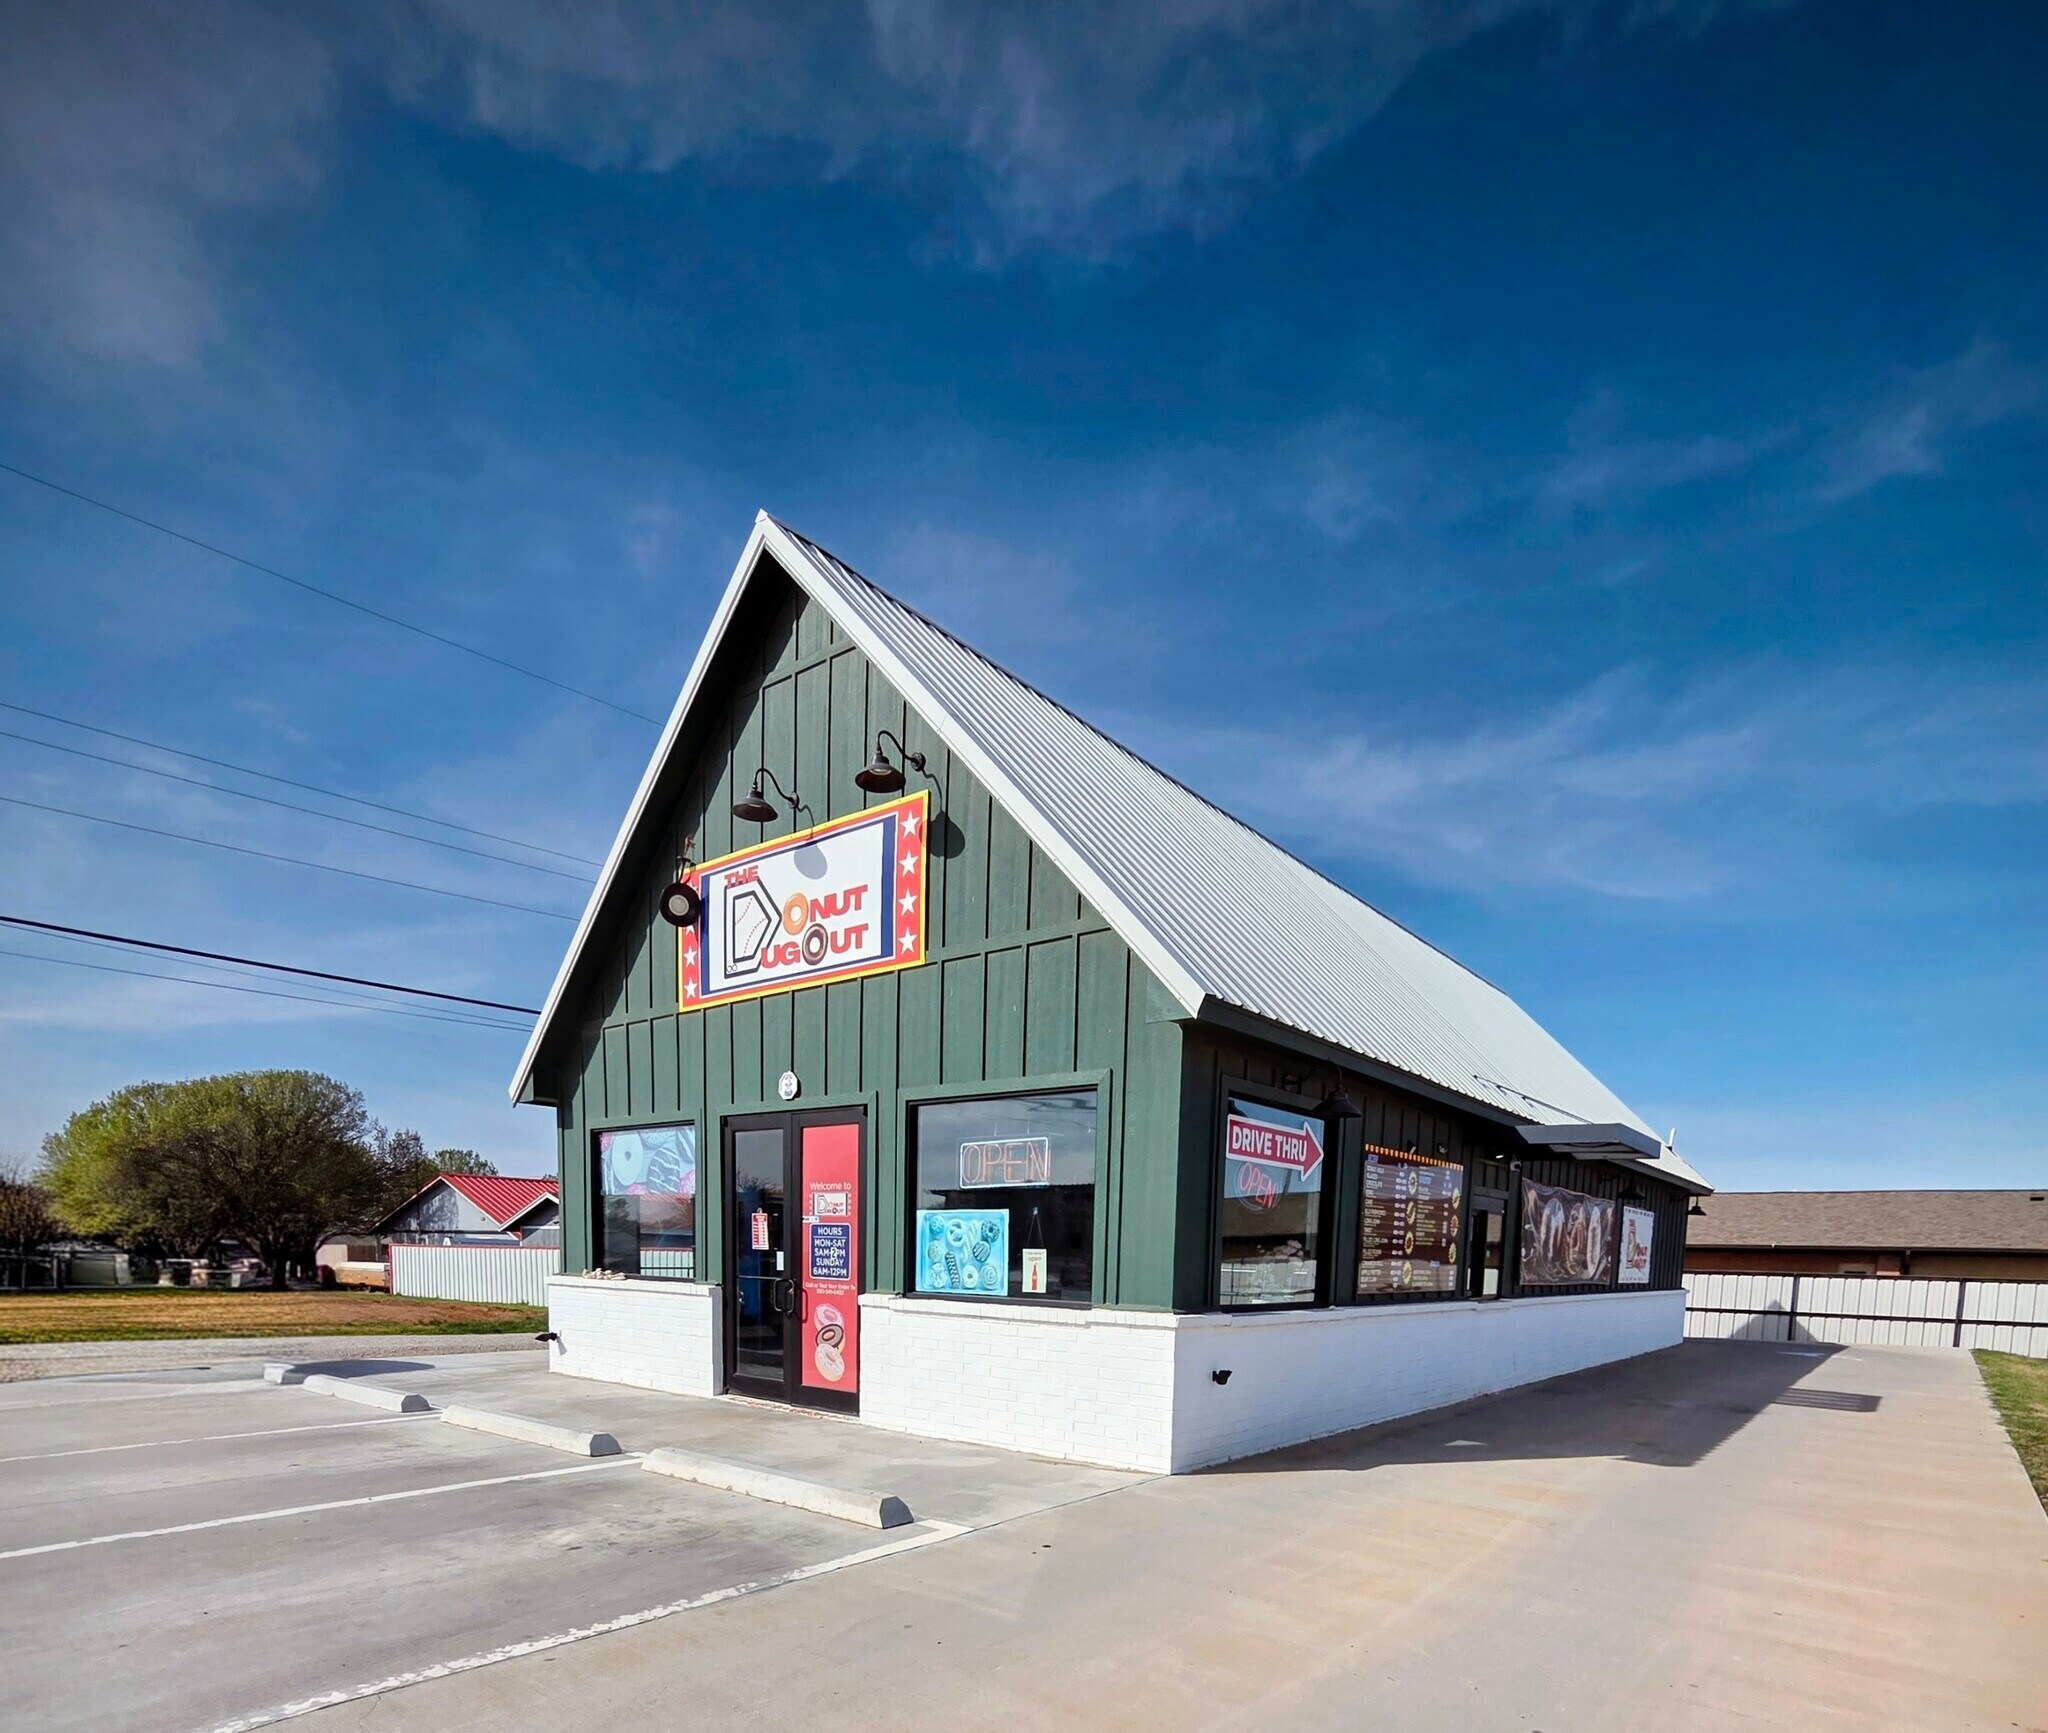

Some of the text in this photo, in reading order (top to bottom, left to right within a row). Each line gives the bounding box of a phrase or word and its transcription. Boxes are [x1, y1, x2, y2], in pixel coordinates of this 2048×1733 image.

[724, 865, 759, 888] THE
[1232, 1125, 1307, 1162] DRIVE THRU
[962, 1141, 1048, 1184] OPEN
[810, 1181, 852, 1190] Welcome to
[1240, 1163, 1276, 1208] OPEN
[817, 1227, 842, 1236] HOURS
[814, 1238, 846, 1247] MON-SAT
[816, 1257, 844, 1267] SUNDAY
[813, 1266, 847, 1276] 6AM-12PM
